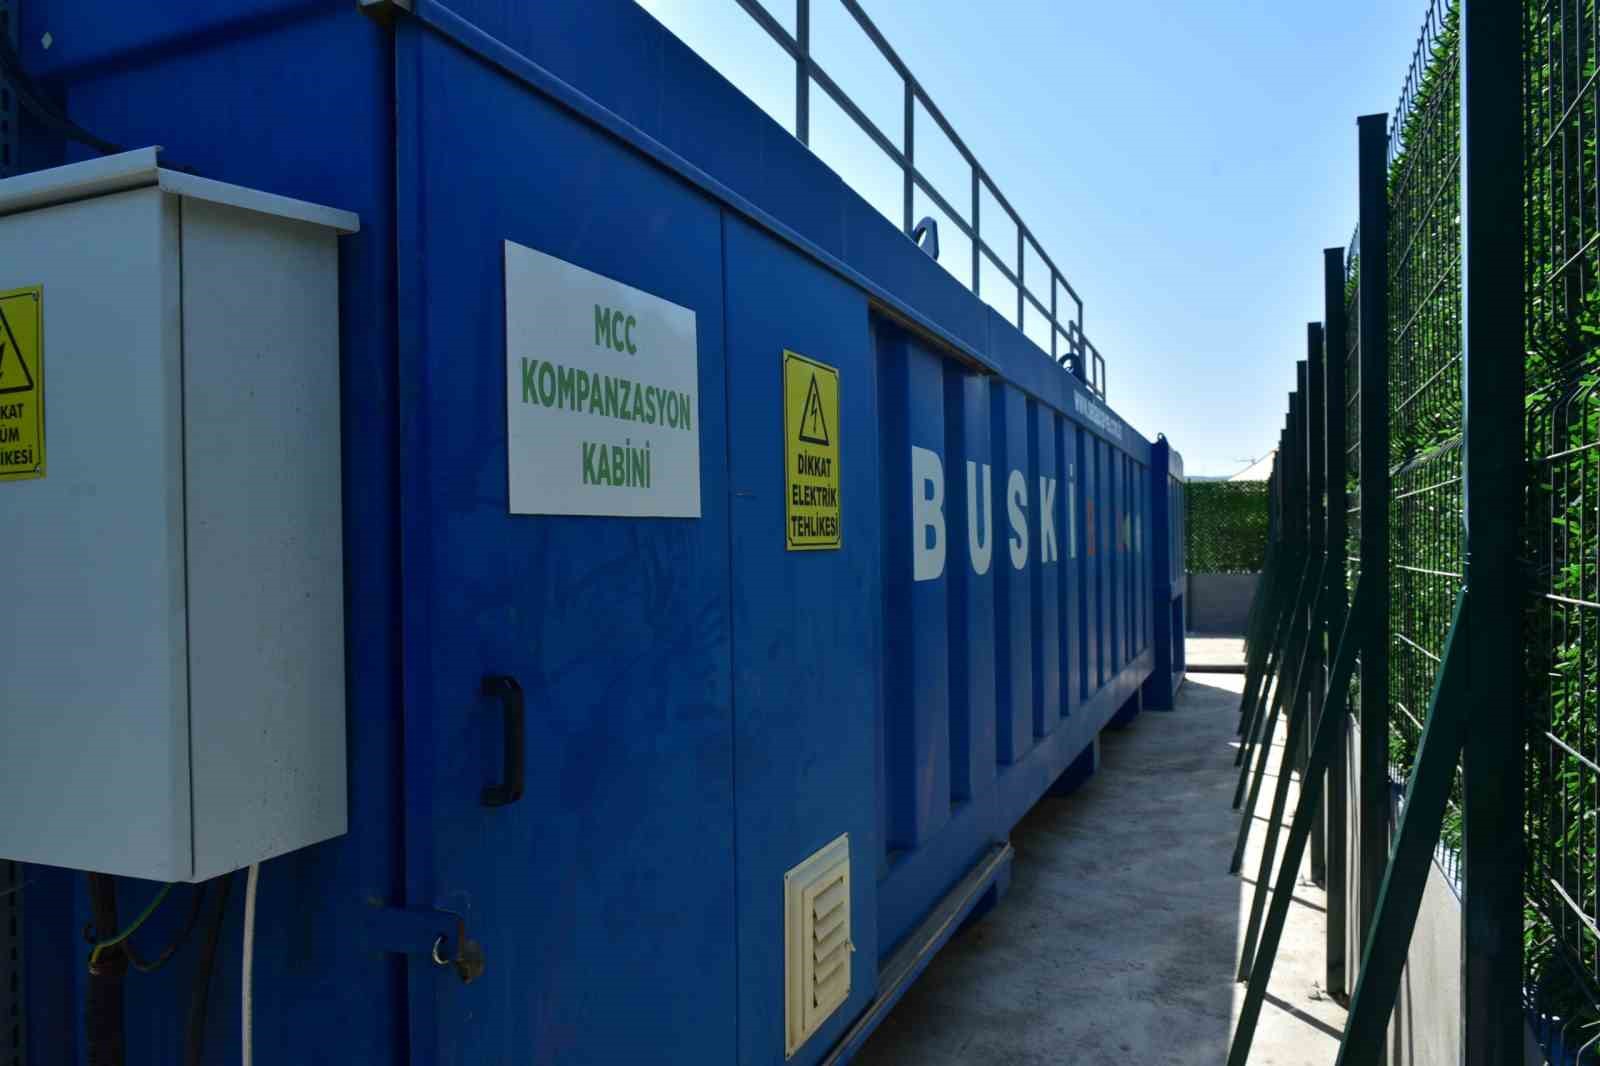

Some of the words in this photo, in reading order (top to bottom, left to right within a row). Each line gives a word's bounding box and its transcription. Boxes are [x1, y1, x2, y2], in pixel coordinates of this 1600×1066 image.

[595, 304, 637, 355] MCC
[521, 357, 691, 430] KOMPANZASYON
[582, 438, 652, 488] KABİNİ
[797, 452, 831, 477] DİKKAT
[792, 483, 837, 506] ELEKTRİK
[911, 445, 1077, 582] BUSKİ
[791, 512, 839, 537] TEHLİKESİ
